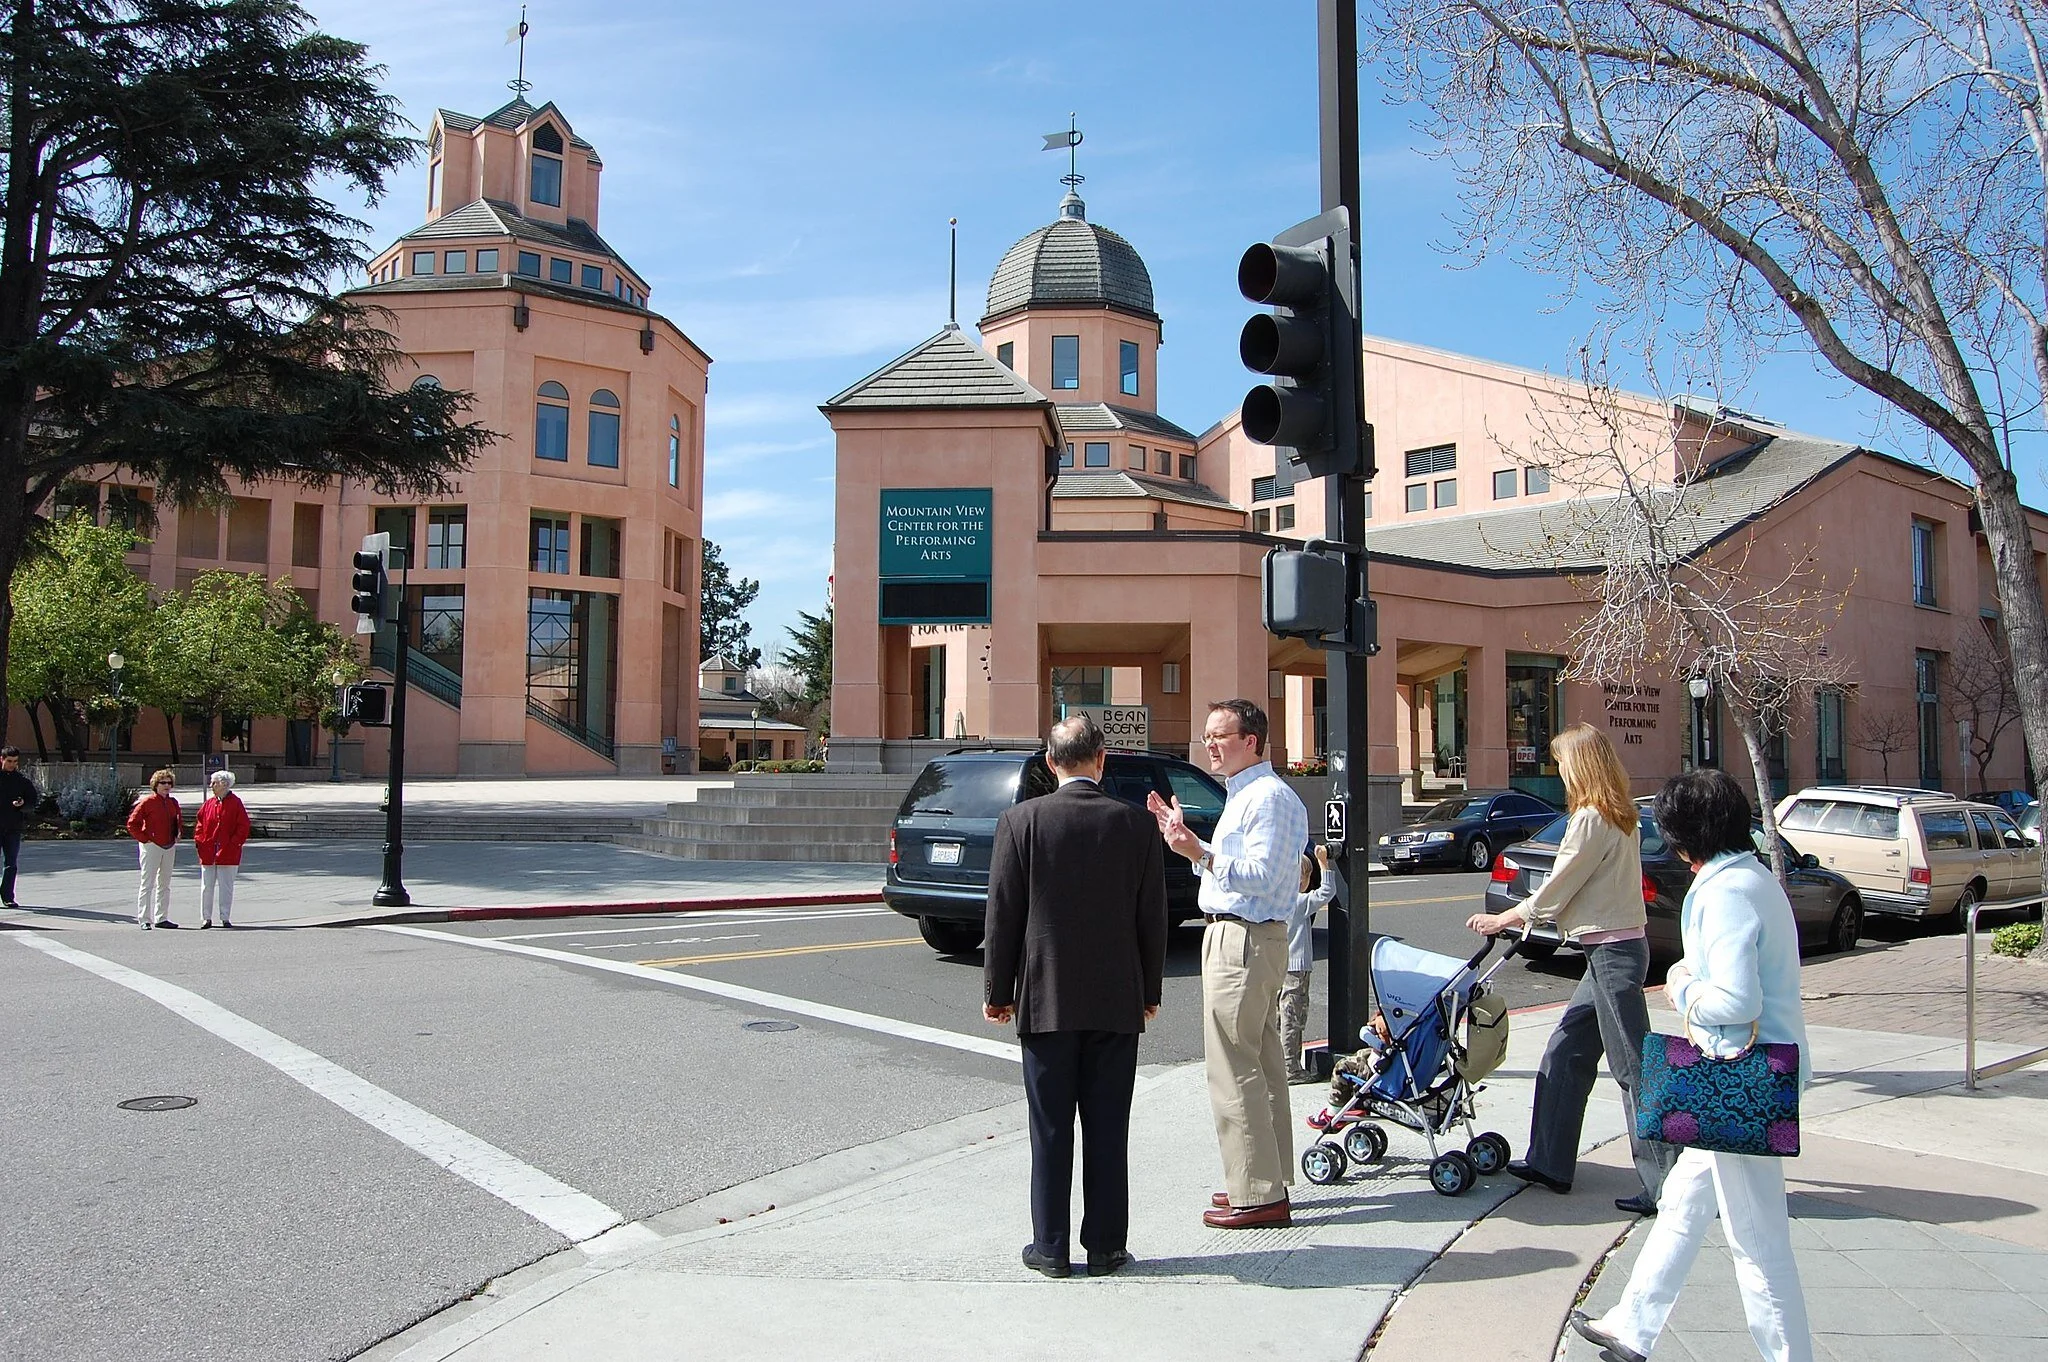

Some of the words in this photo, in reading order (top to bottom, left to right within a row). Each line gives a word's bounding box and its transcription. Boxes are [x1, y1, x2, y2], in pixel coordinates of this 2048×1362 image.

[886, 505, 952, 517] MOUNTAIN
[955, 505, 986, 517] VIEW
[887, 520, 934, 532] CENTER
[936, 521, 959, 532] FOR
[961, 521, 984, 531] THE
[896, 535, 976, 546] PERFORMING
[920, 549, 952, 561] ARTS
[1604, 682, 1641, 695] MOUNTAN
[1643, 685, 1660, 697] VIEW
[1605, 698, 1632, 711] CENTER
[1633, 702, 1646, 712] FOR
[1647, 703, 1659, 713] THE
[1103, 710, 1146, 722] BEAN
[1609, 715, 1656, 729] PERFORMING
[1103, 723, 1146, 735] SCENE
[1624, 732, 1642, 744] ARTS
